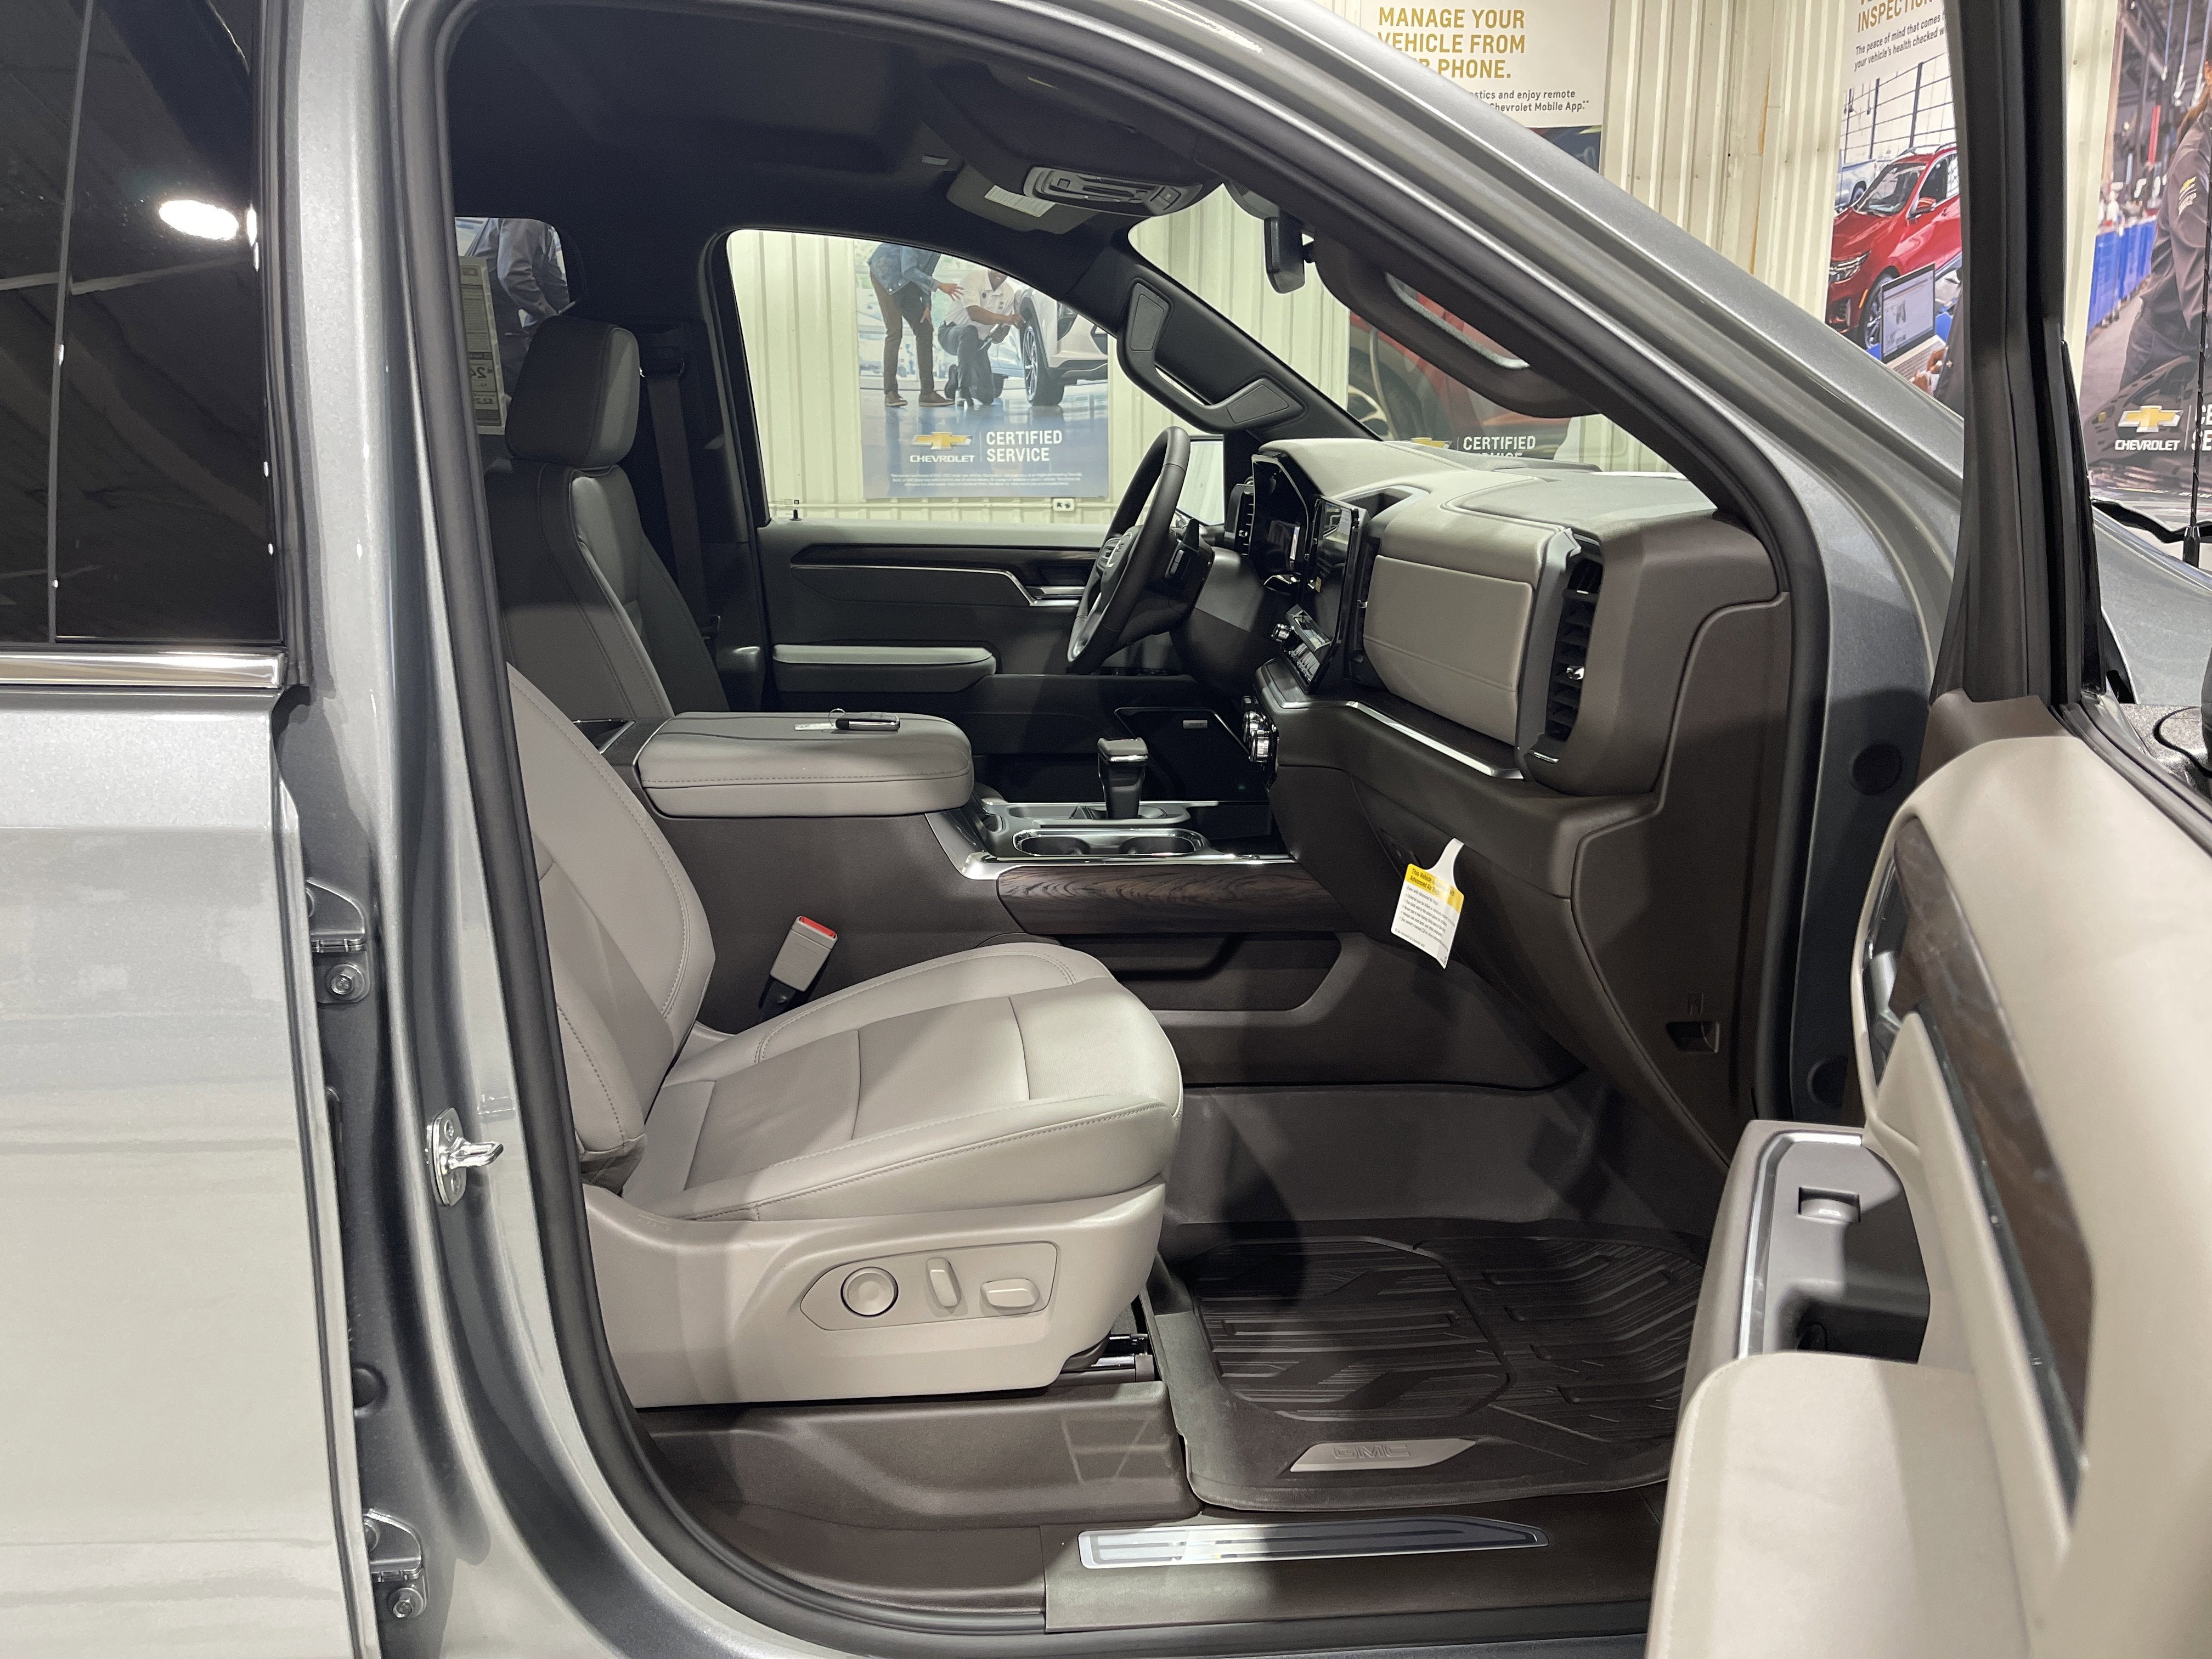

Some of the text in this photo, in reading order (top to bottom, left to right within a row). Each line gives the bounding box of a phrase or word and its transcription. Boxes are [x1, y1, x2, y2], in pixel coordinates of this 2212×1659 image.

[1379, 7, 1525, 29] MANAGE YOUR
[1855, 44, 1866, 55] The
[1866, 38, 1883, 54] peace
[1884, 32, 1891, 44] of
[1891, 26, 1906, 41] mind
[1907, 21, 1920, 35] that
[1921, 14, 1941, 29] comes
[1378, 32, 1525, 53] VEHICLE FROM
[1854, 58, 1867, 72] your
[1868, 46, 1892, 64] vehicle's
[1893, 38, 1912, 55] health
[1912, 27, 1939, 47] checked
[1438, 59, 1511, 78] PHONE.
[1498, 90, 1514, 99] and
[1517, 89, 1541, 101] enjoy
[1543, 89, 1576, 99] remote
[1534, 101, 1563, 111] Mobile
[986, 430, 1063, 445] CERTIFIED
[1463, 436, 1536, 450] CERTIFIED
[2115, 439, 2181, 451] CHEVROLET
[910, 455, 975, 463] CHEVROLET
[986, 447, 1050, 462] SERVICE
[1333, 1444, 1411, 1459] GMC
